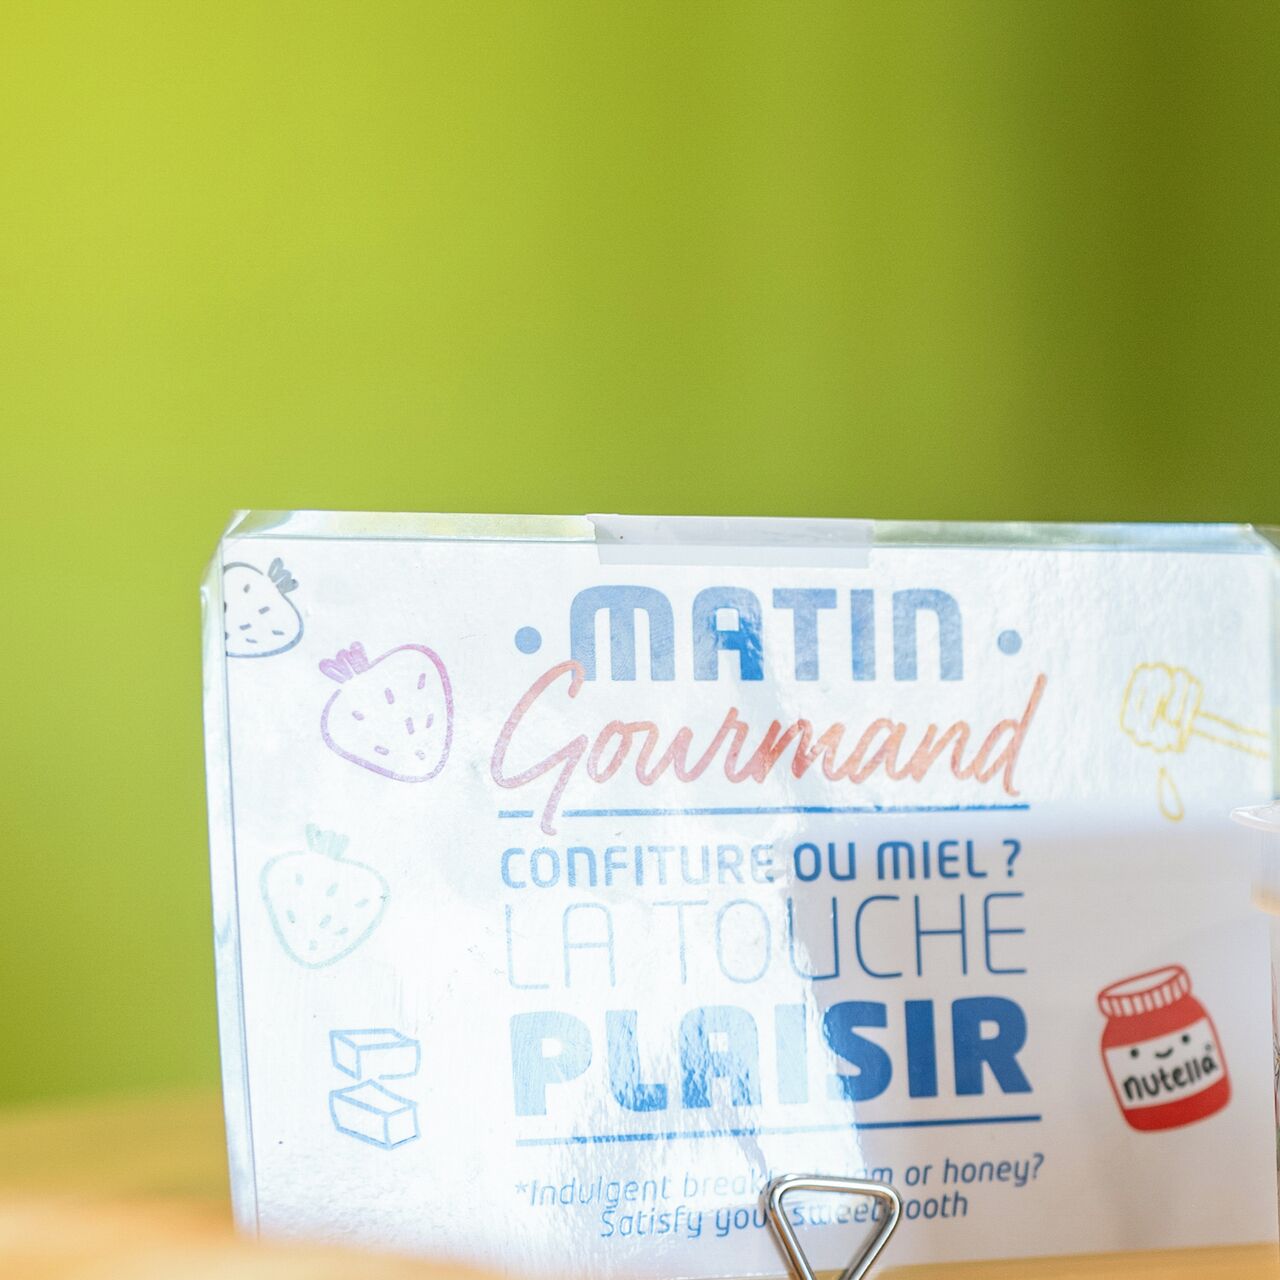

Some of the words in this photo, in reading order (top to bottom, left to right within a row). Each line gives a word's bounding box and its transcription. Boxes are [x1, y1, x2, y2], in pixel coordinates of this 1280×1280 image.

[569, 584, 964, 682] MATIN
[489, 659, 1048, 836] Gourmand
[500, 843, 776, 889] CONFITURE
[793, 842, 857, 882] OU
[876, 840, 987, 880] MIEL
[1002, 839, 1022, 878] ?
[505, 900, 617, 990] LA
[652, 892, 1028, 984] TOUCHE
[509, 995, 1034, 1117] PLAISIR
[1122, 1054, 1218, 1101] nutella
[683, 1166, 826, 1198] break
[905, 1163, 932, 1187] or
[944, 1153, 1045, 1188] honey?
[600, 1204, 703, 1237] Satisfy
[716, 1206, 771, 1237] you
[896, 1190, 968, 1221] ooth
